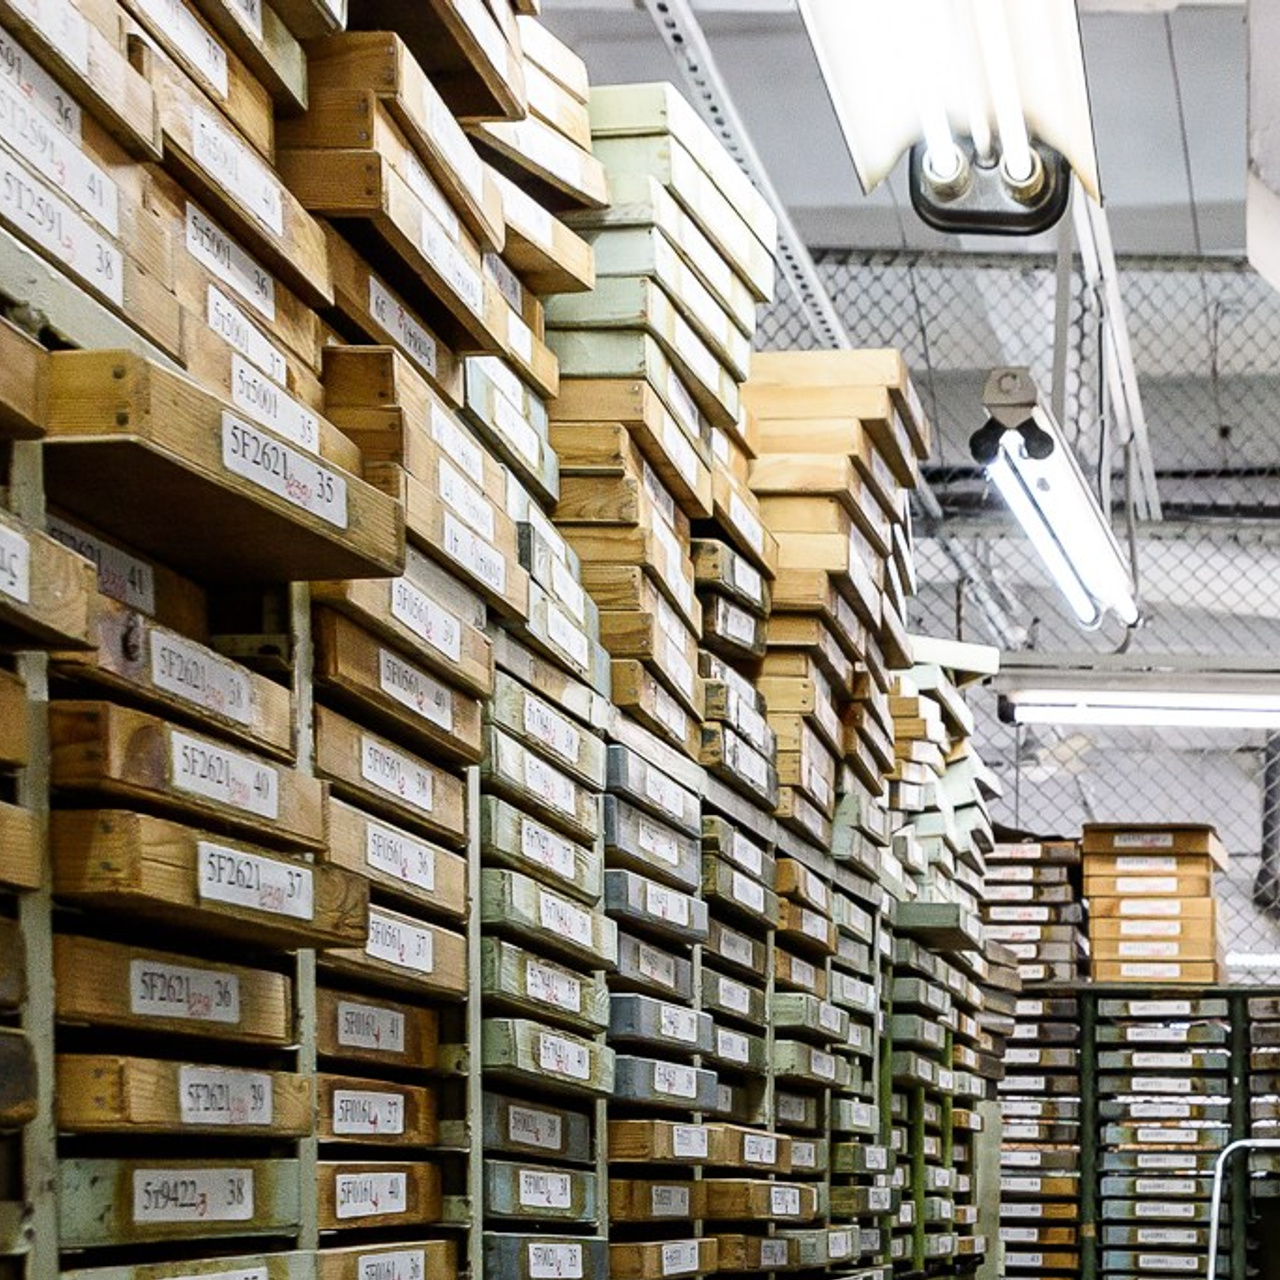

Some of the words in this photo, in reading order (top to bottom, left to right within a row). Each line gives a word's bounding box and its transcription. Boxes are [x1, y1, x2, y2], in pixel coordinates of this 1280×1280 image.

[96, 240, 112, 284] 38
[231, 423, 287, 481] 5F2621
[317, 469, 333, 506] 35
[159, 643, 206, 692] 5F2621
[181, 744, 230, 788] 5F2621
[253, 770, 268, 800] 40
[207, 853, 260, 891] 5F2621
[287, 871, 301, 900] 37
[139, 972, 189, 1004] 5F2621
[214, 981, 230, 1008] 36
[187, 1082, 230, 1111] 5F2621
[250, 1085, 263, 1110] 39
[227, 1179, 244, 1204] 38
